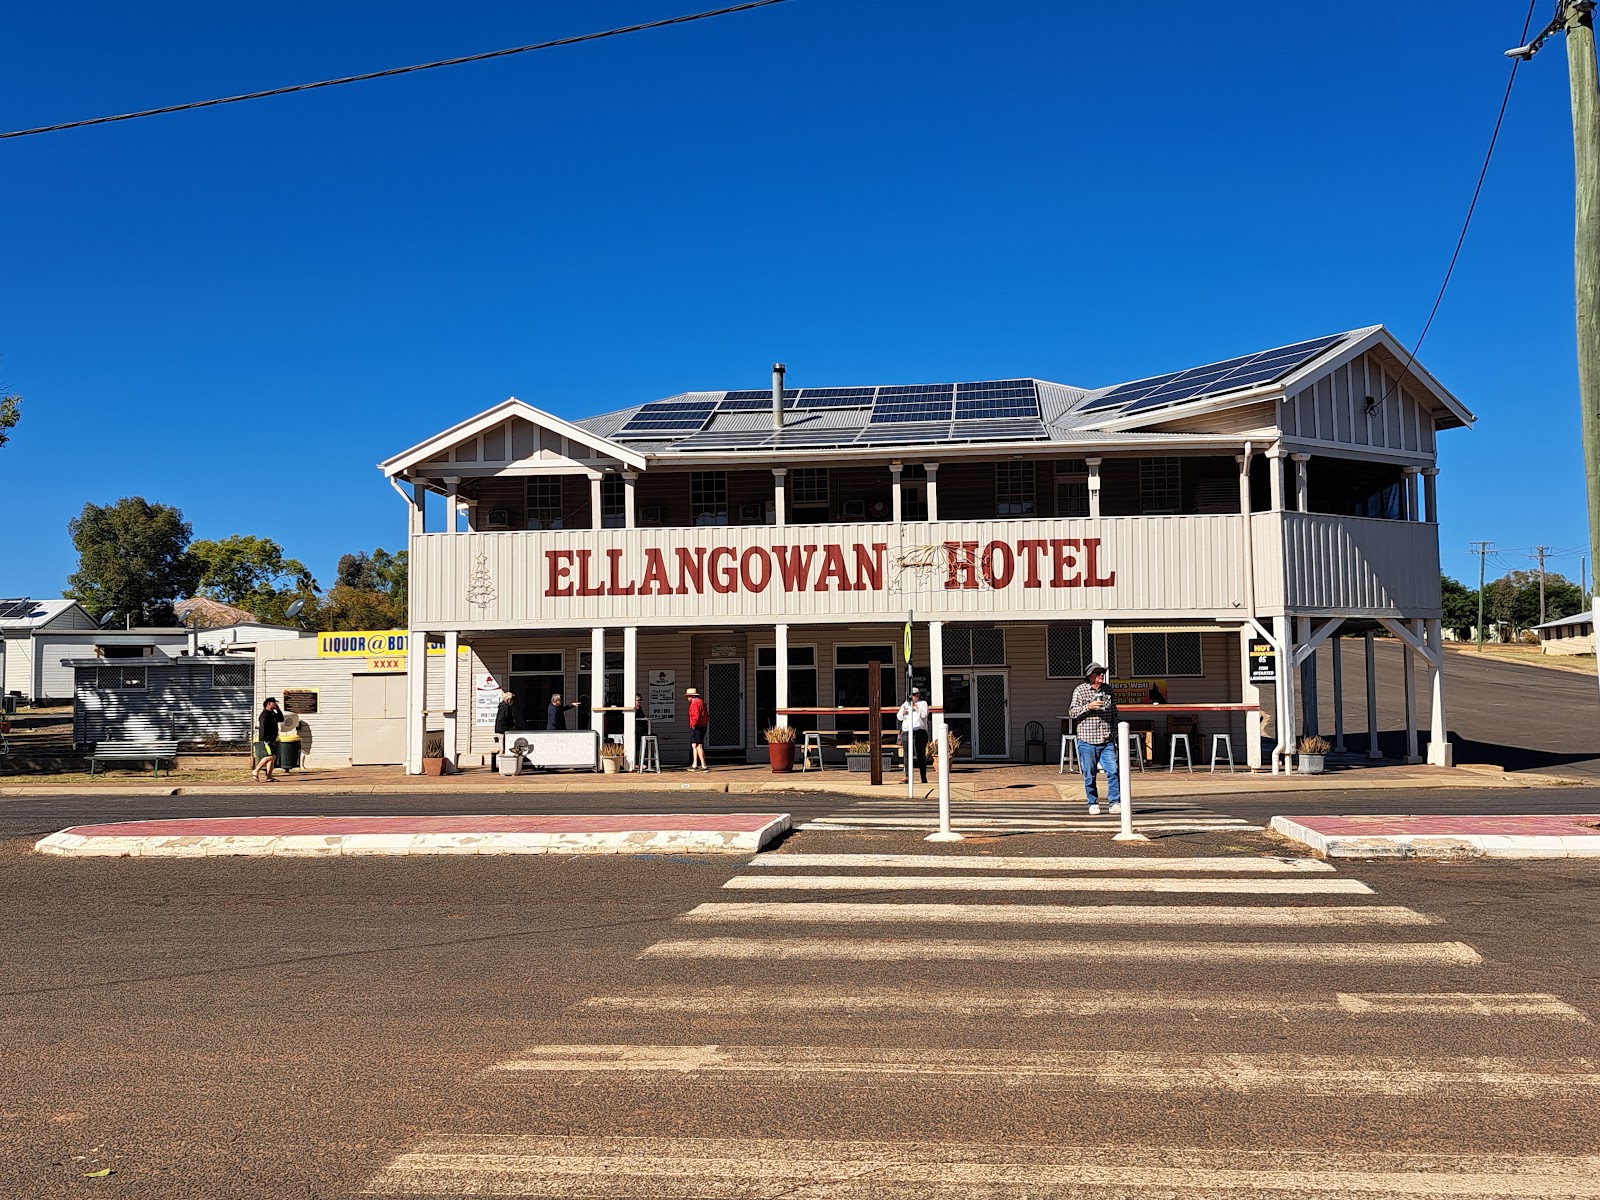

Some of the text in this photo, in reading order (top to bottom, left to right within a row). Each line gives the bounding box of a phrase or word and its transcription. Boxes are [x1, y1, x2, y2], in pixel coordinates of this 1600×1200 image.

[545, 538, 1116, 597] ELLANGOWAN HOTEL
[1254, 644, 1271, 652] HOT
[373, 660, 399, 669] XXXX
